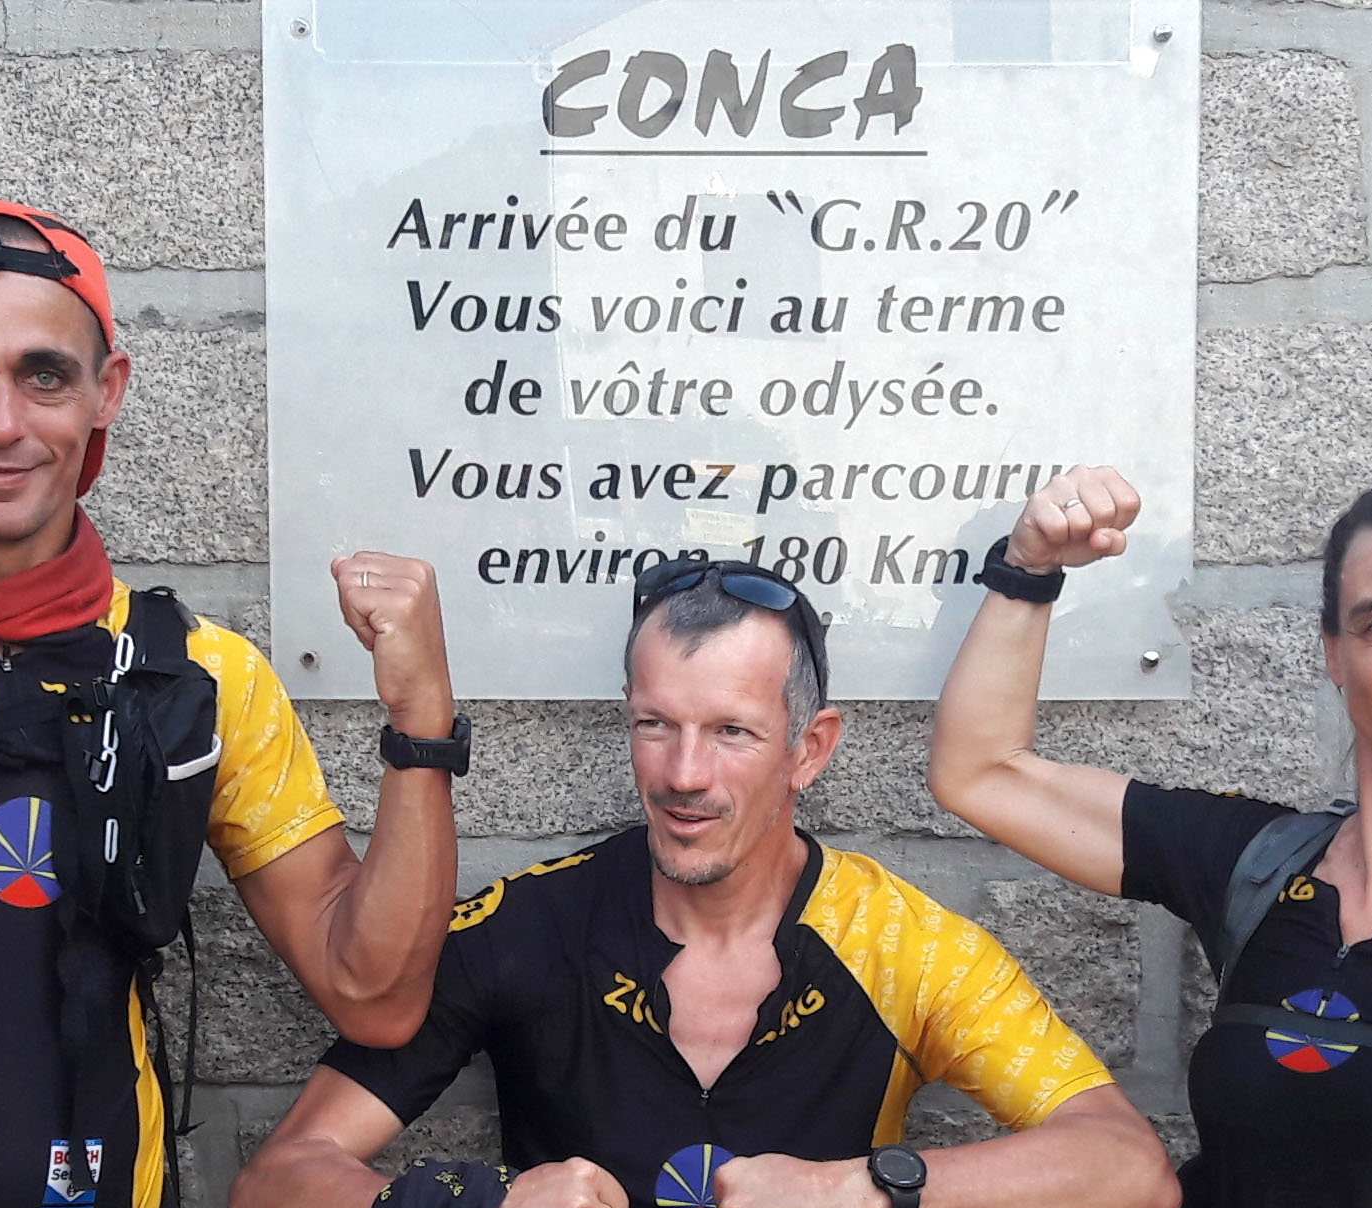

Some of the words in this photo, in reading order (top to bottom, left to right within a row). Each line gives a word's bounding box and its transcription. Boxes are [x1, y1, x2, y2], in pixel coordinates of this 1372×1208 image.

[541, 43, 924, 141] CONCA
[387, 194, 629, 252] Arrivée
[654, 194, 737, 252] du
[406, 279, 563, 334] Vous
[591, 277, 747, 334] voici
[769, 291, 855, 334] au
[875, 284, 1066, 334] terme
[464, 360, 543, 417] de
[568, 363, 735, 417] vôtre
[758, 360, 1000, 430] odysée.
[407, 448, 563, 502] Vous
[588, 461, 735, 502] avez
[742, 535, 848, 586] 180
